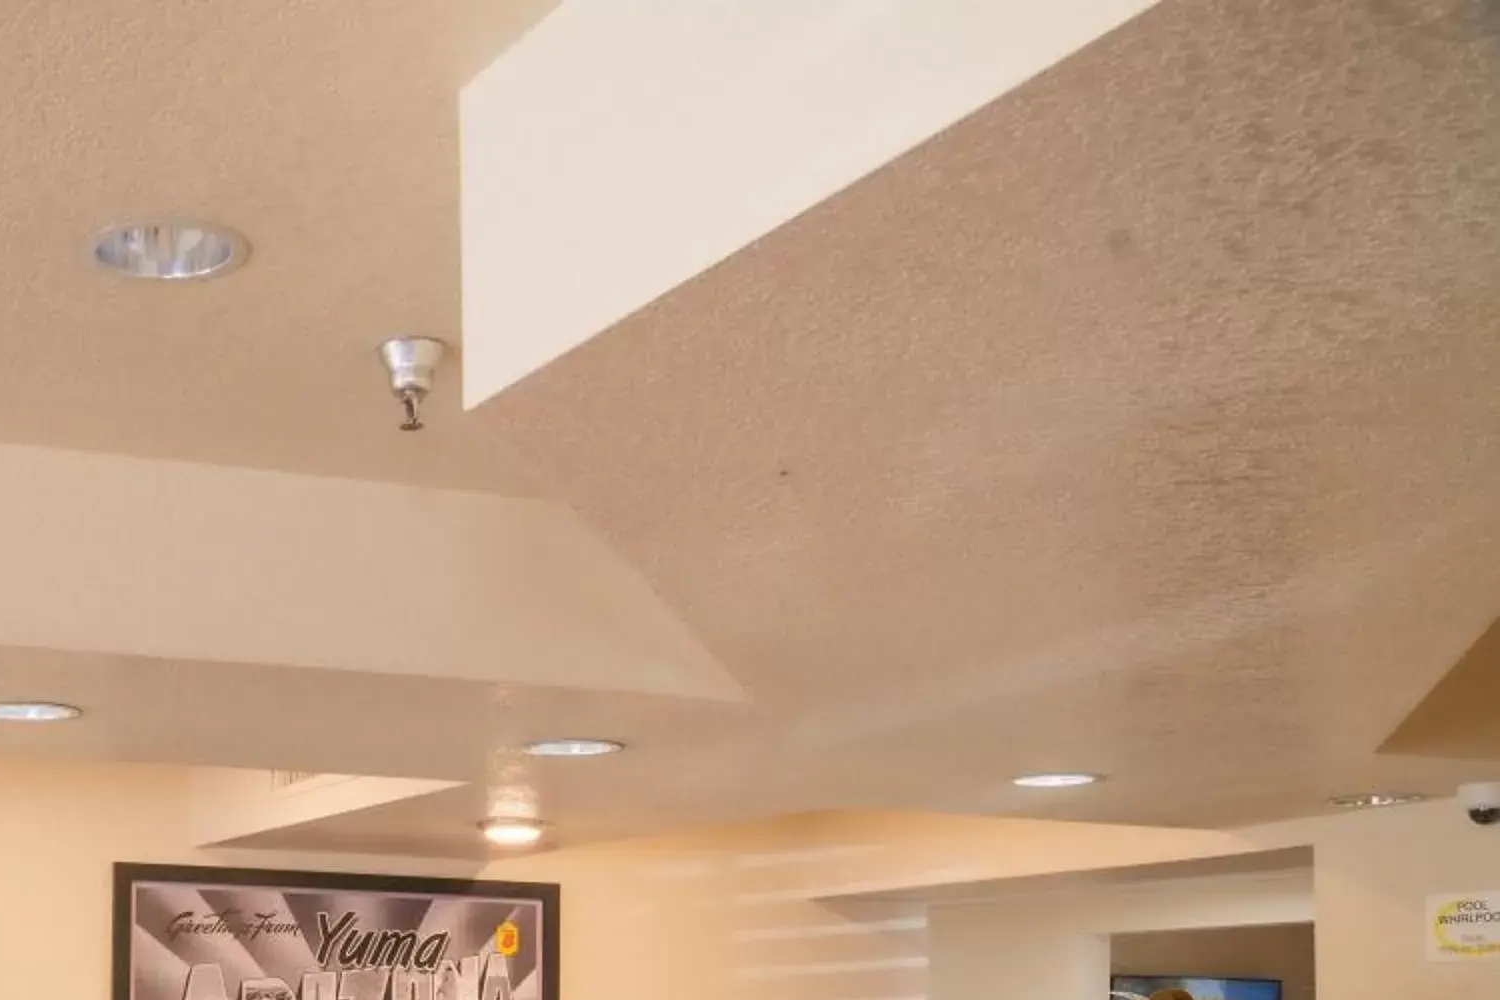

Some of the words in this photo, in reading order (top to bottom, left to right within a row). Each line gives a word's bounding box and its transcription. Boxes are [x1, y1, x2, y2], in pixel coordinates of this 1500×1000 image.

[1456, 900, 1488, 912] POOL
[166, 908, 253, 942] Greetis
[316, 911, 450, 972] Yuma
